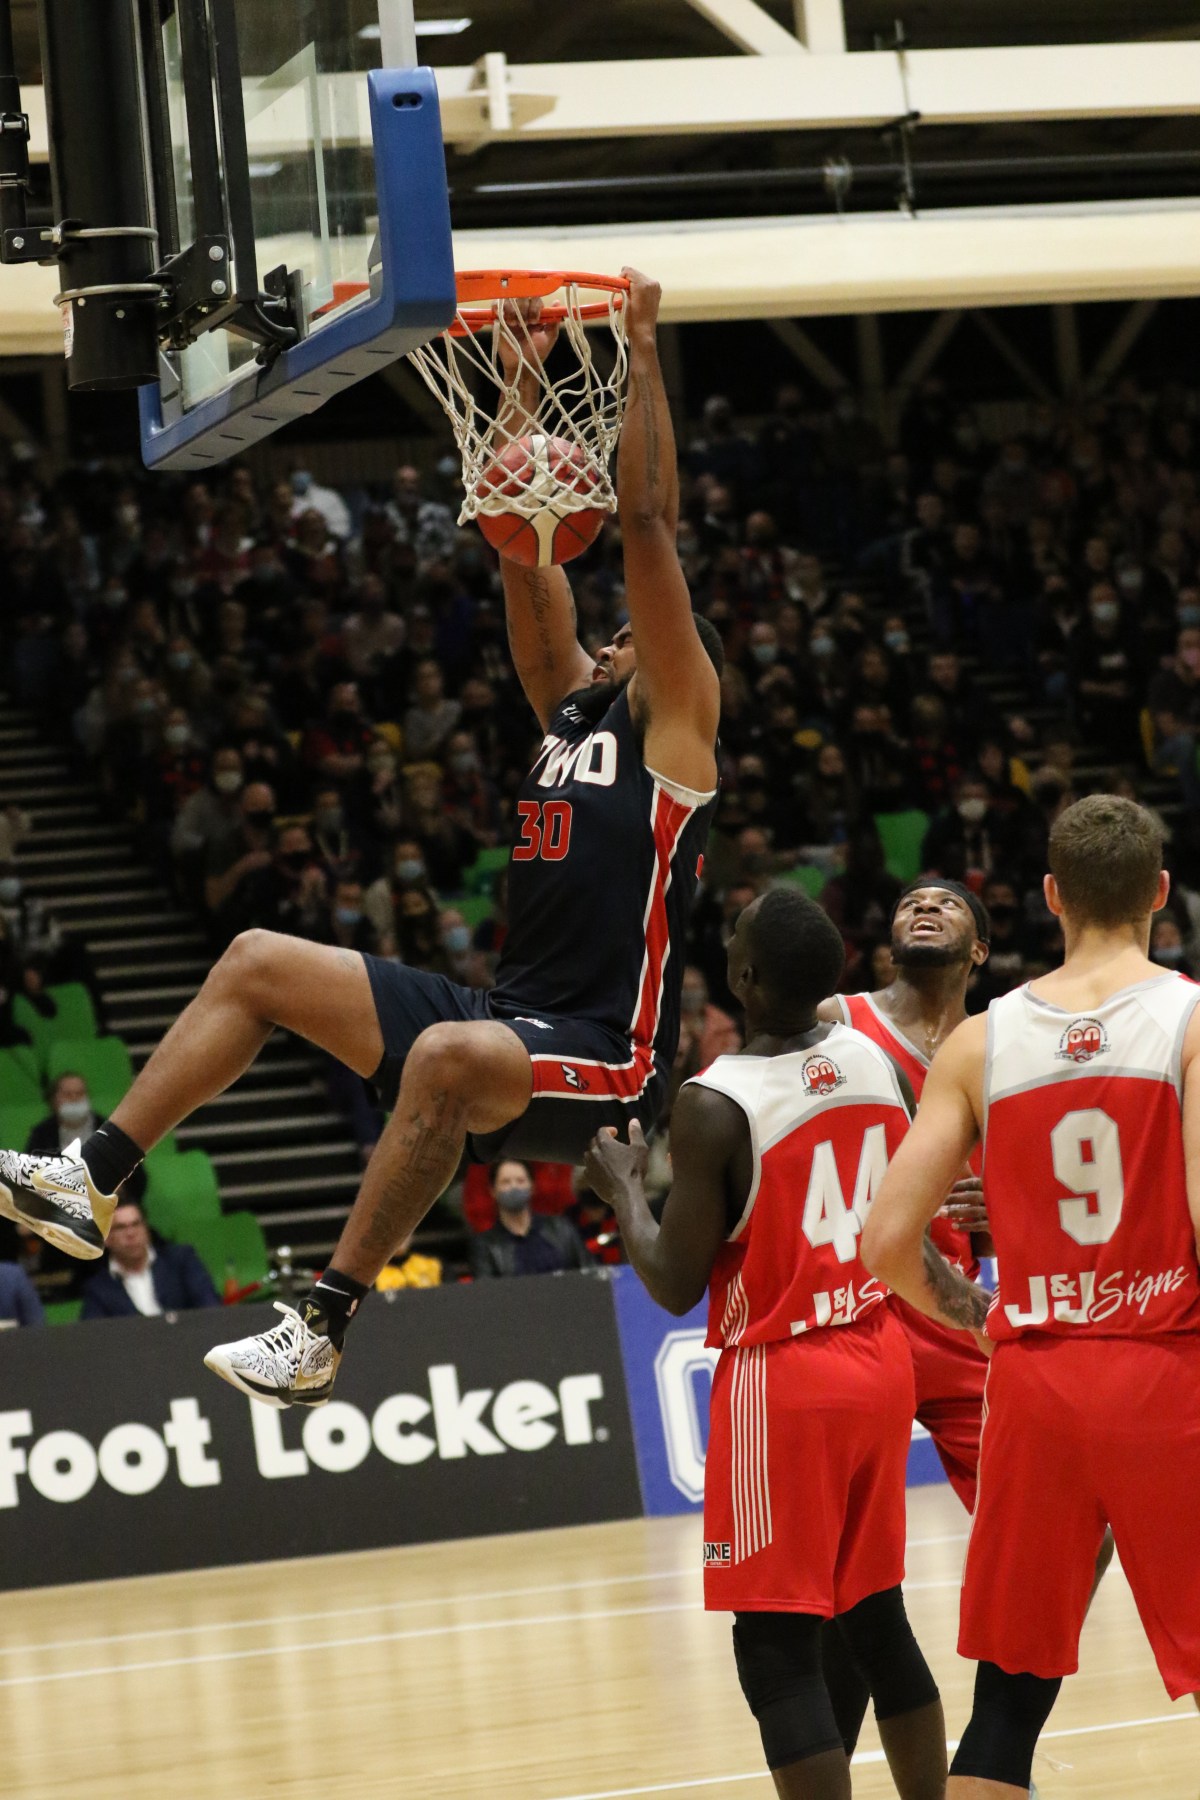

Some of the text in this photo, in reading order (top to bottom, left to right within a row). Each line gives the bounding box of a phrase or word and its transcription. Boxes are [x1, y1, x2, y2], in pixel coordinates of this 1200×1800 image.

[512, 800, 573, 861] 30
[801, 1123, 889, 1263] 44
[1050, 1107, 1125, 1246] 9
[1004, 1265, 1191, 1328] J&J Signs
[249, 1364, 603, 1479] Locker
